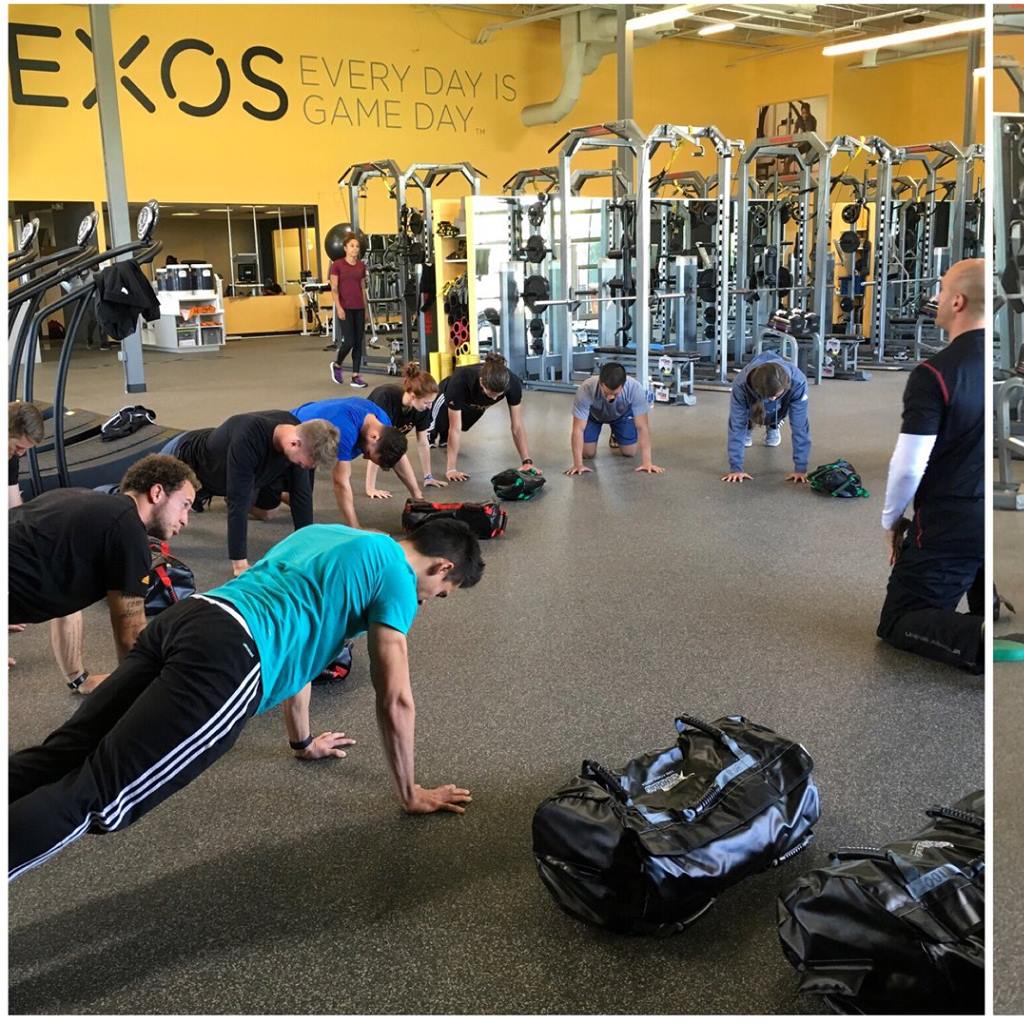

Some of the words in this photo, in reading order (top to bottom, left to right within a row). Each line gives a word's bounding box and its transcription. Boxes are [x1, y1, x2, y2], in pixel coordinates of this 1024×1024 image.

[8, 22, 289, 121] EXOS
[300, 54, 411, 93] EVERY
[424, 66, 483, 98] DAY
[495, 73, 518, 103] IS
[303, 94, 403, 129] GAME
[415, 101, 474, 133] DAY
[475, 128, 486, 136] TM
